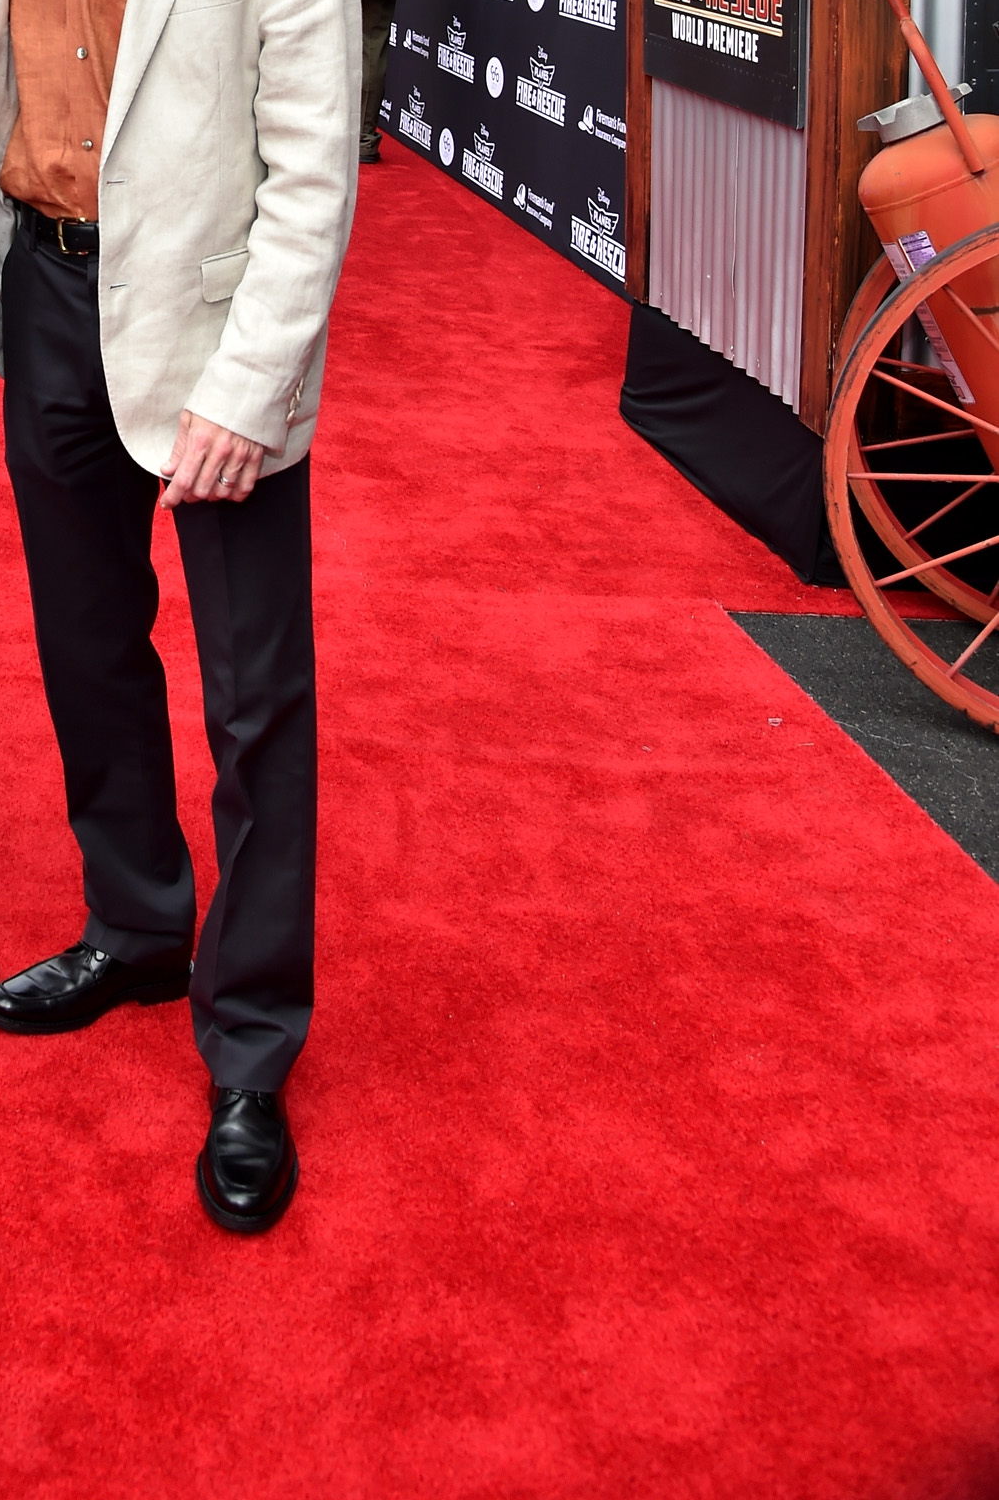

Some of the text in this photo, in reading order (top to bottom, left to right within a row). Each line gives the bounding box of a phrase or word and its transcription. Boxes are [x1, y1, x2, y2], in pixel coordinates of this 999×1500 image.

[671, 11, 759, 63] WORLD PREMIERE
[534, 66, 549, 81] PLANES
[593, 209, 612, 230] PLANES
